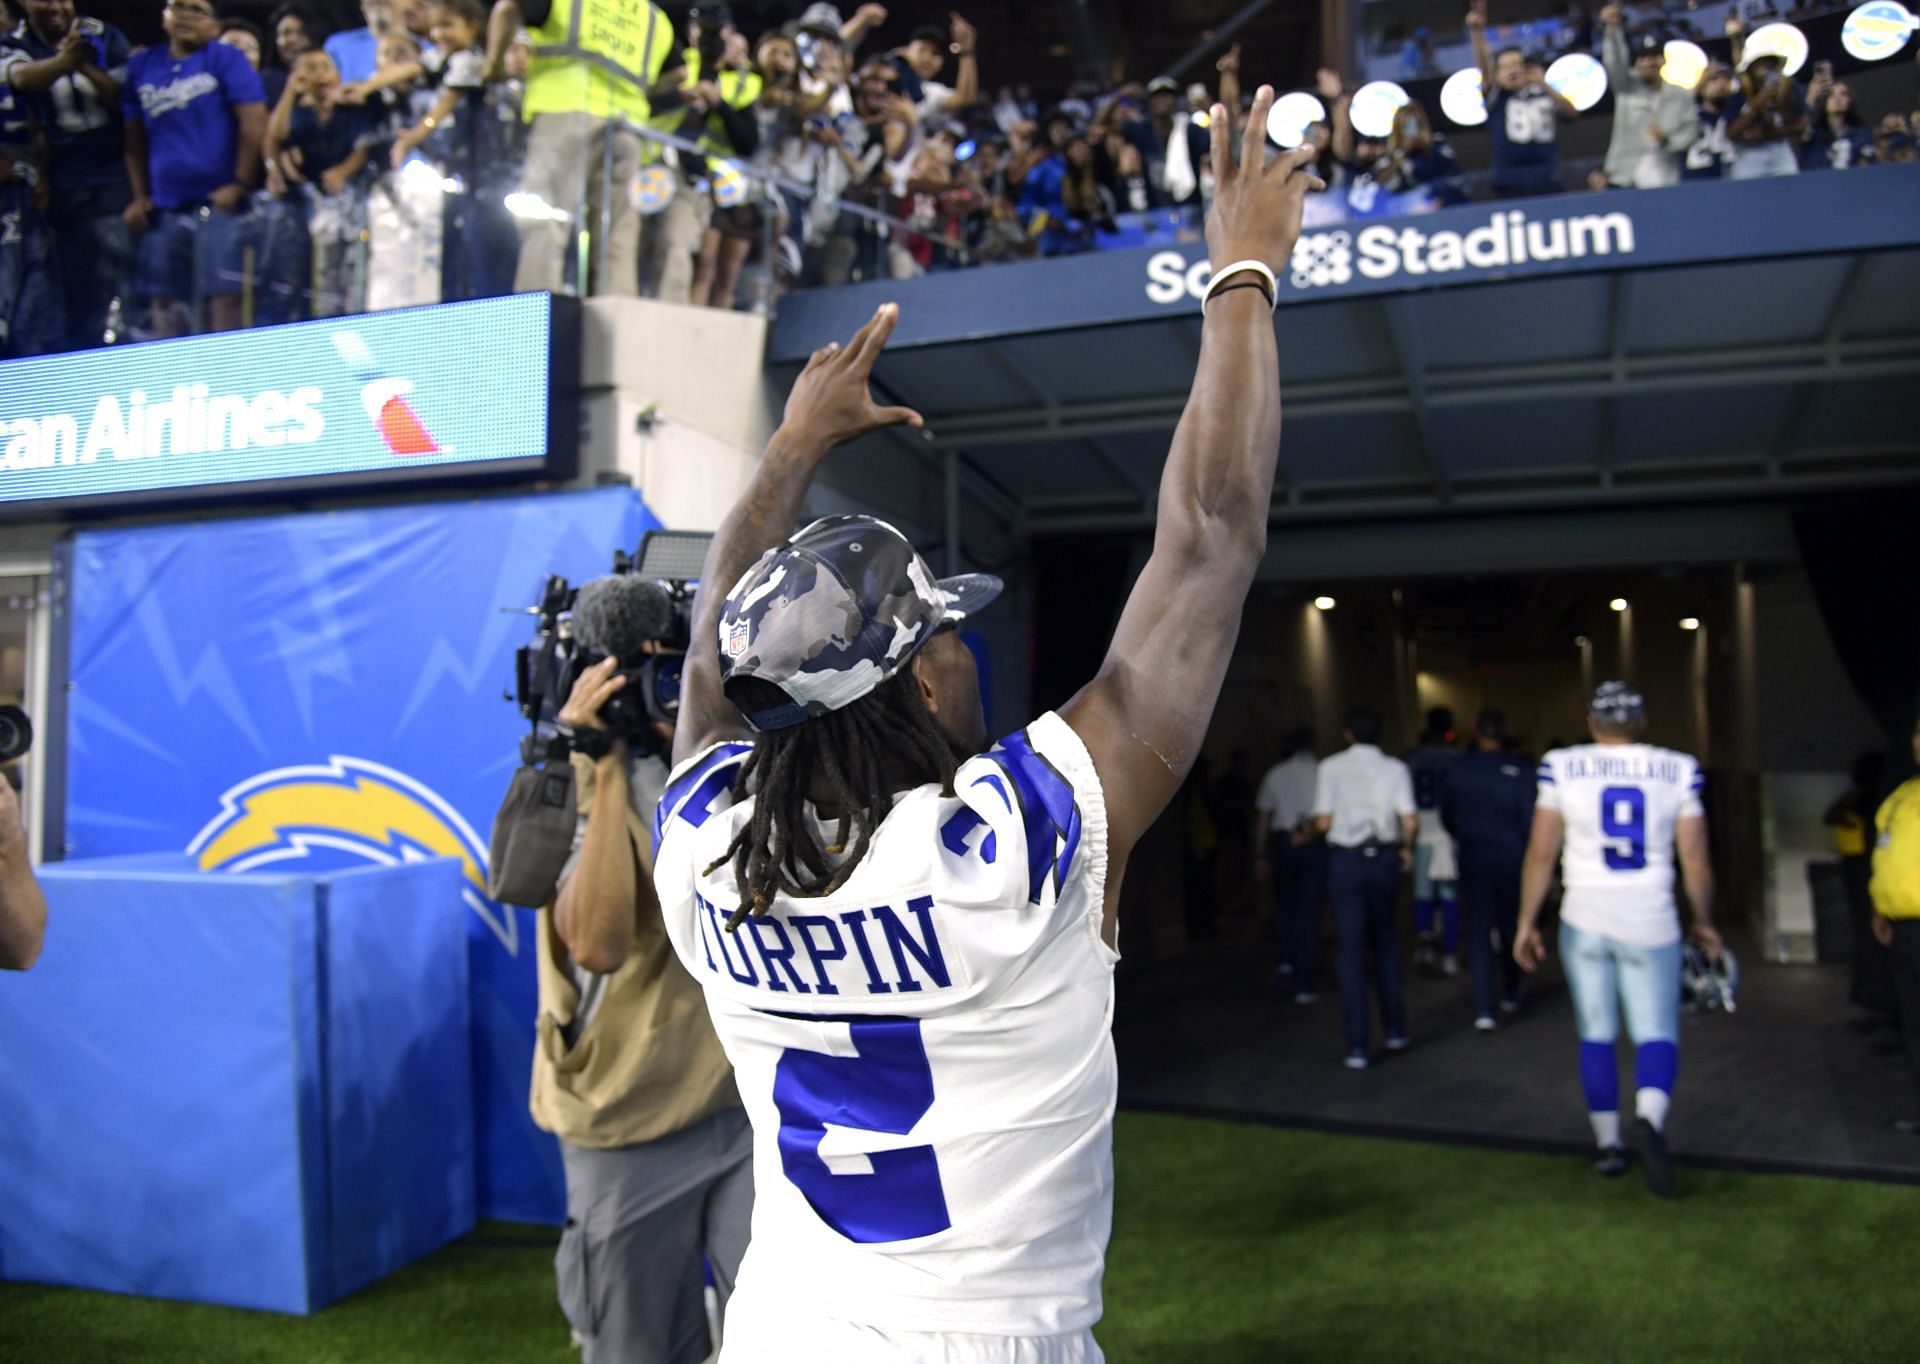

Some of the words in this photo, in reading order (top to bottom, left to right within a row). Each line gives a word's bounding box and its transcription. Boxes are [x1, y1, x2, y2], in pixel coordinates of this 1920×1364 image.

[1357, 211, 1636, 279] Stadium
[80, 383, 325, 461] Airlines
[1602, 787, 1647, 870] 9
[696, 893, 953, 995] TURPIN
[751, 1009, 953, 1244] 2
